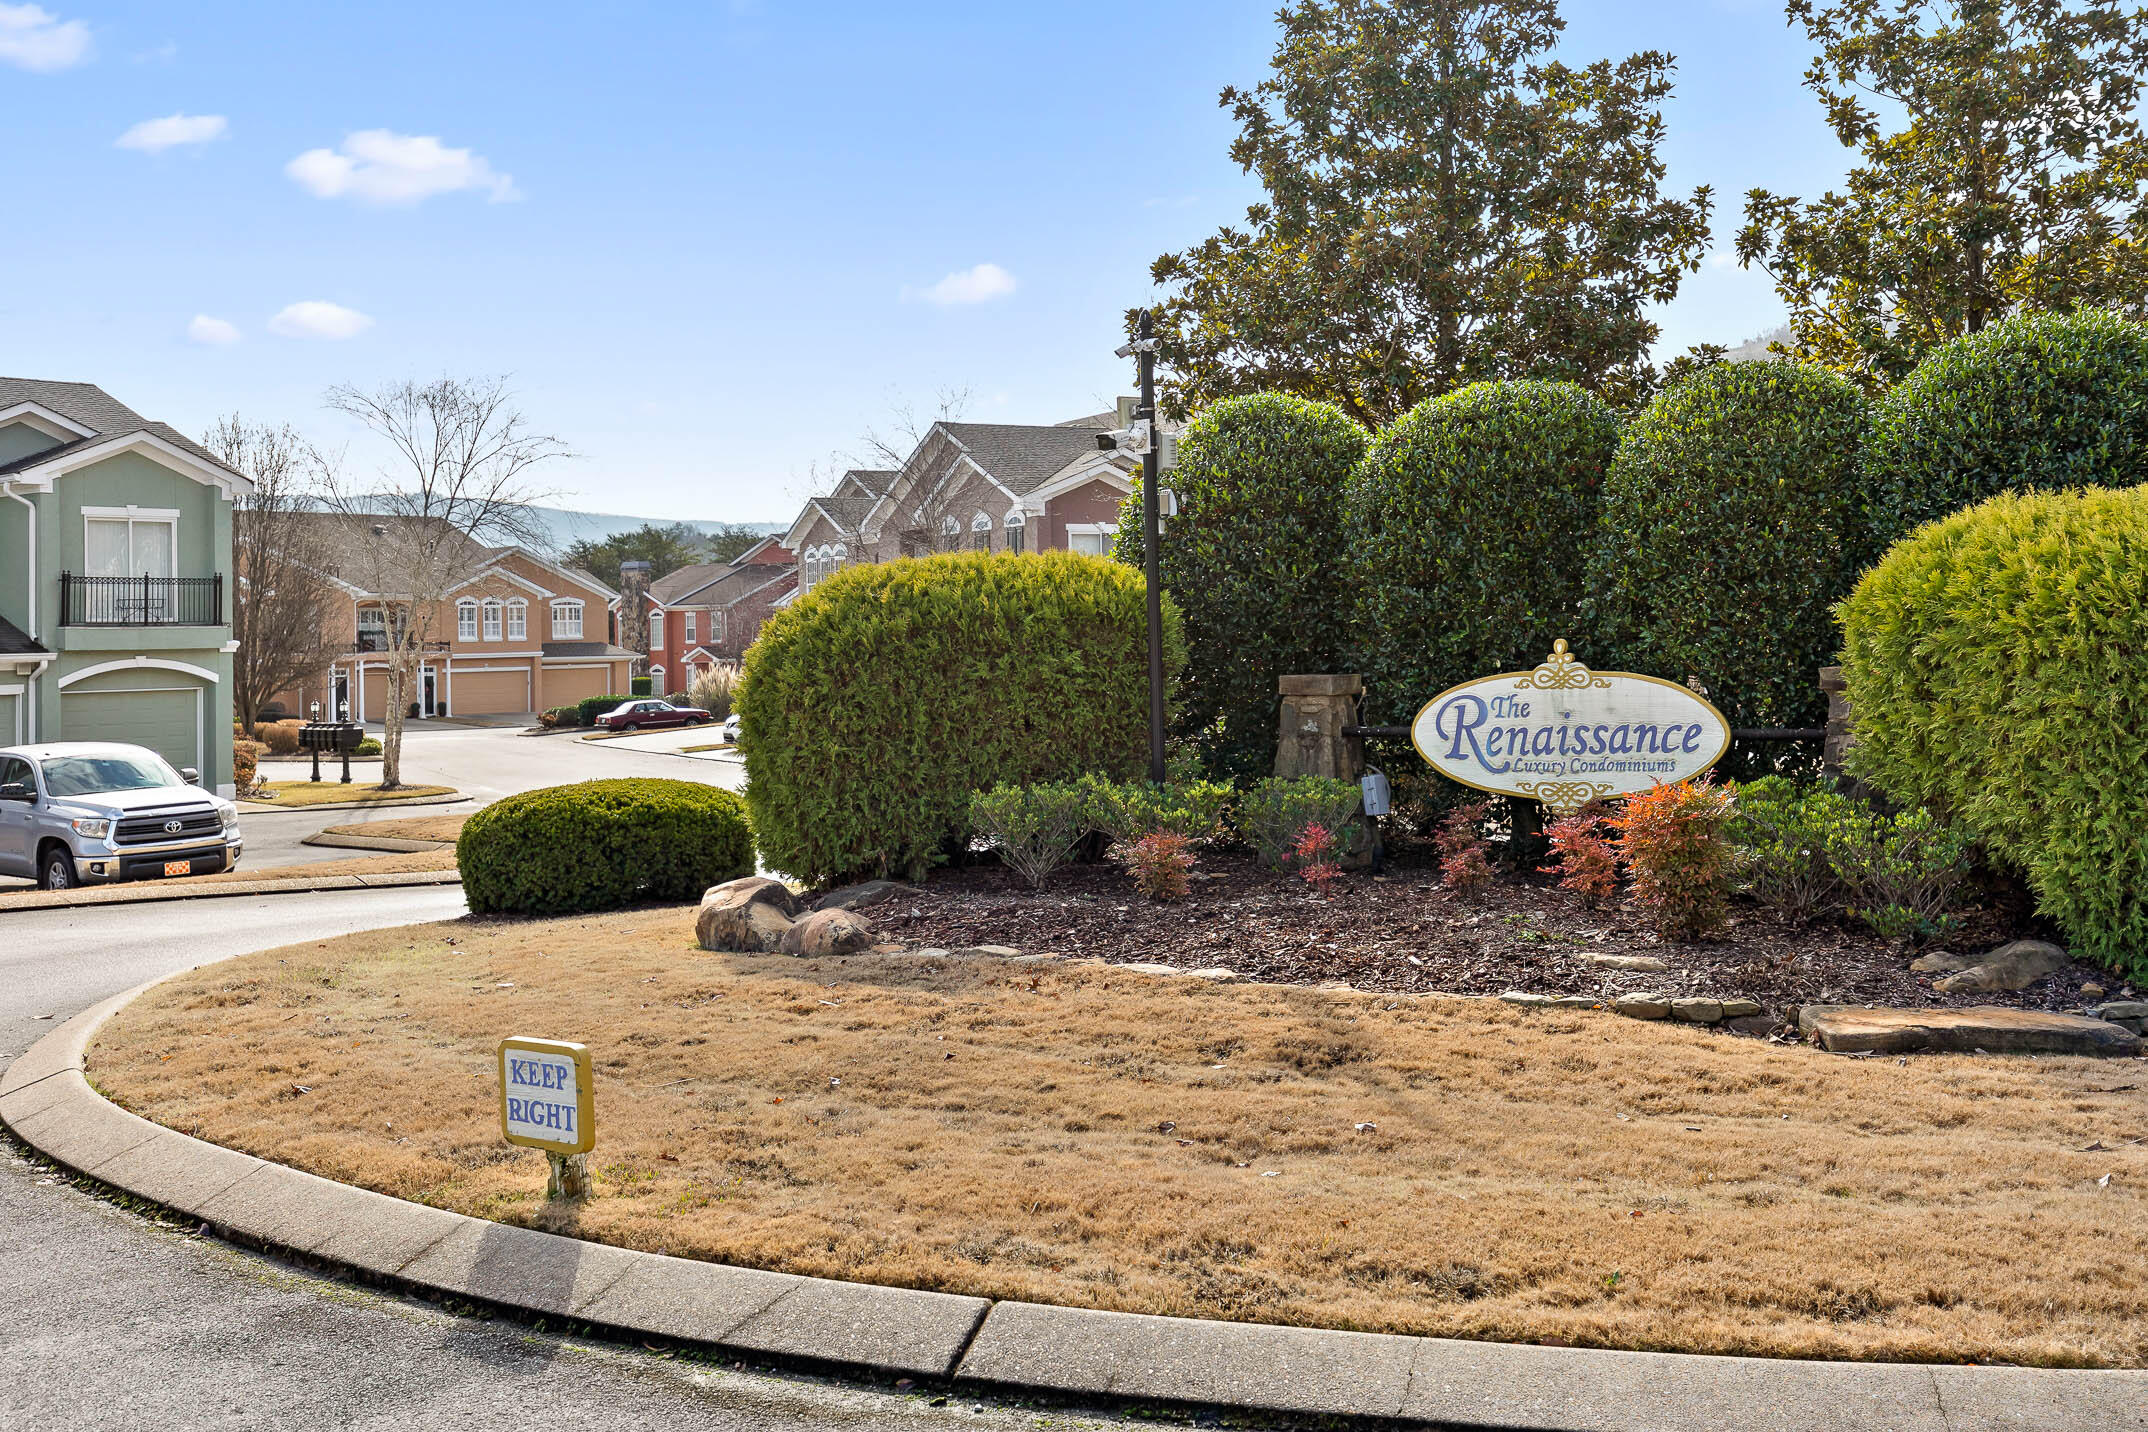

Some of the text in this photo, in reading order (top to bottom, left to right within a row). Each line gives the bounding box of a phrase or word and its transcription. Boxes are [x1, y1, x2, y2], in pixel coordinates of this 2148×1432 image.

[1490, 693, 1531, 719] The
[1435, 694, 1703, 774] Renaissance
[1511, 757, 1676, 777] Luxury Condominiums
[510, 1058, 568, 1091] KEEP
[508, 1097, 576, 1132] RIGHT
